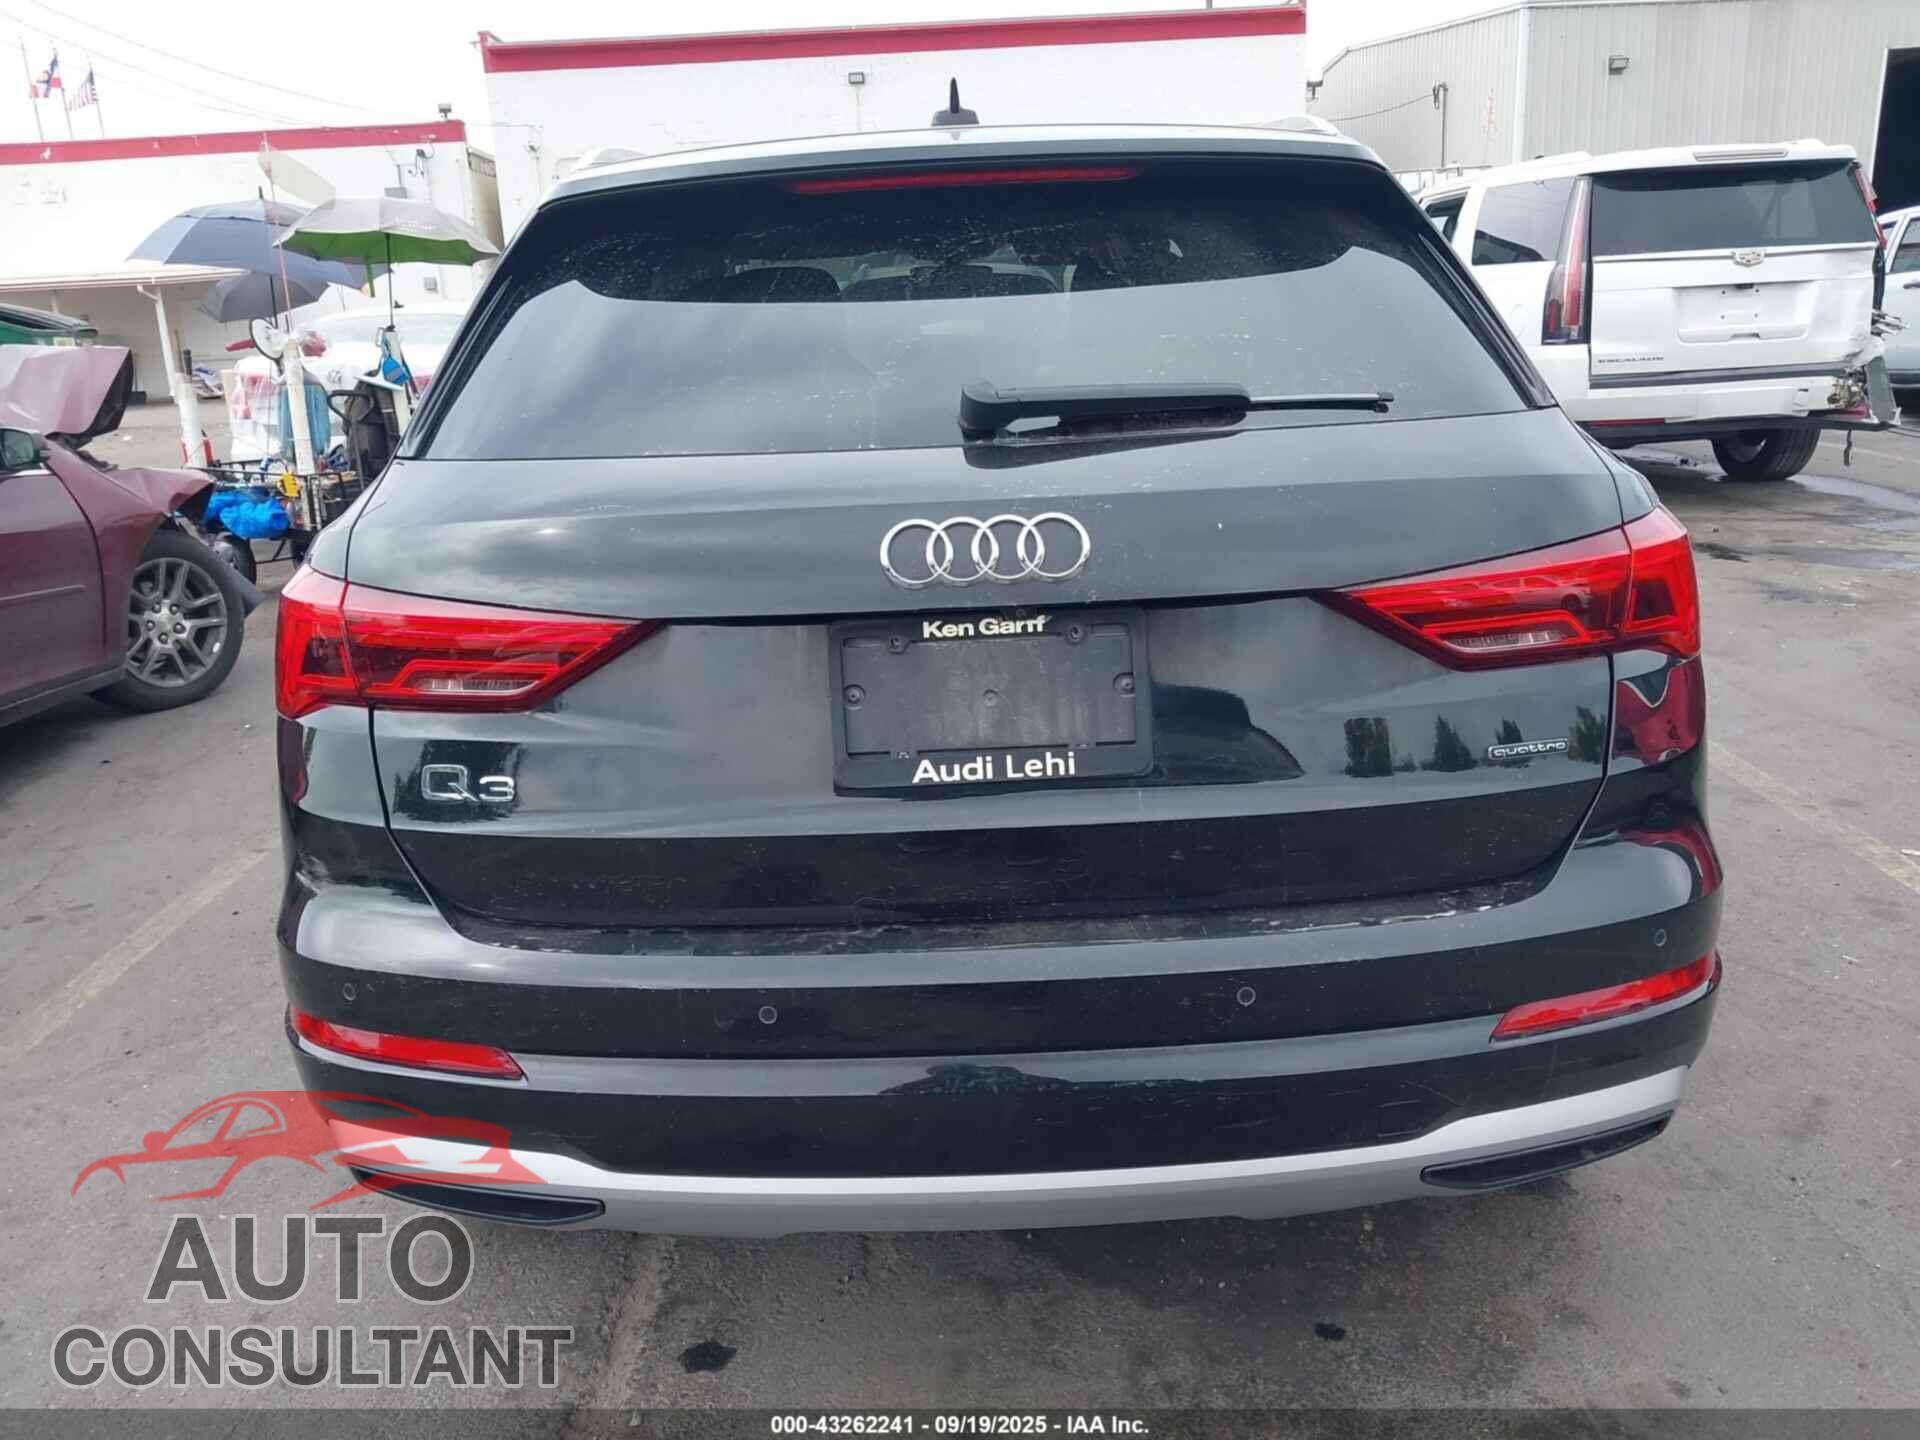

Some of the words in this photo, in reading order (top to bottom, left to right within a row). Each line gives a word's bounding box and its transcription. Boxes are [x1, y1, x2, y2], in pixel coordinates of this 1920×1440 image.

[922, 620, 975, 639] Ken
[1493, 742, 1566, 758] quattro
[912, 755, 993, 784] Audi
[1006, 751, 1076, 779] Lehi
[421, 764, 515, 802] Q3
